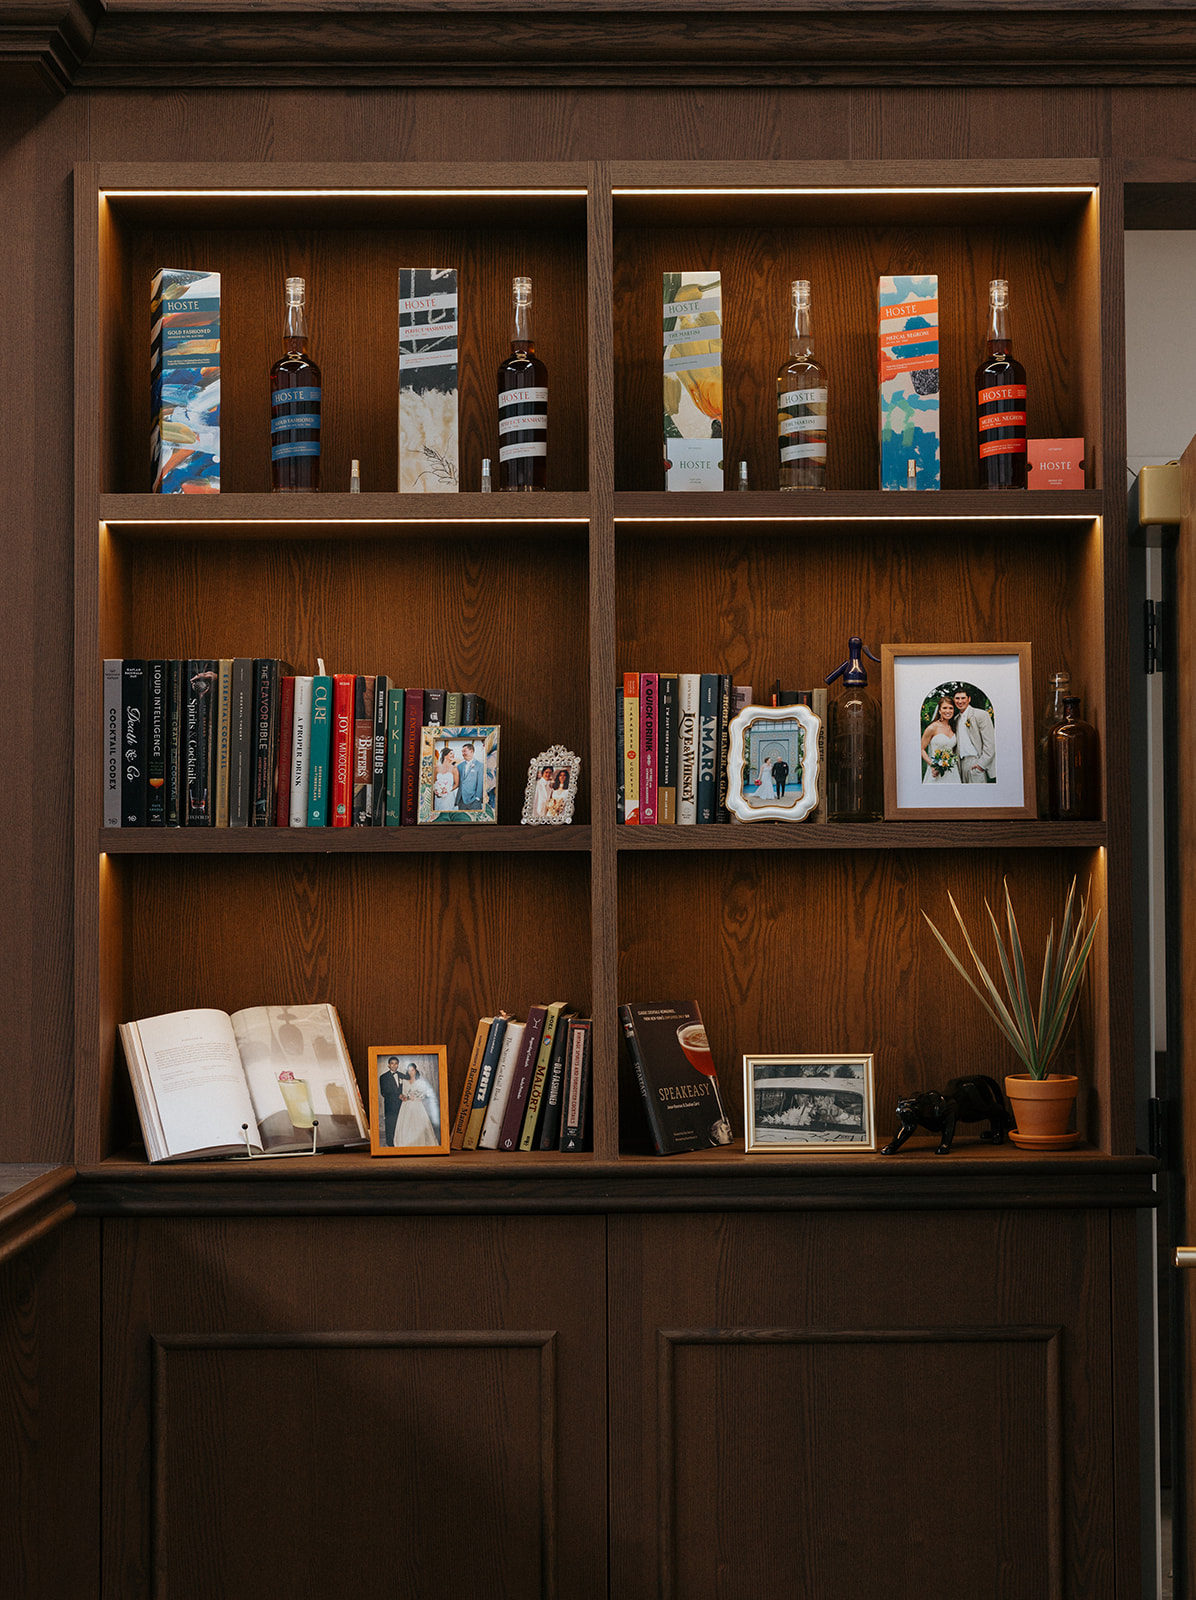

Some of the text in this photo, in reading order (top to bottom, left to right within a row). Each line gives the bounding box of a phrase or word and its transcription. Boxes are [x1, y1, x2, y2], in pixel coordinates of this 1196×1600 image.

[168, 301, 200, 310] HOSTE
[404, 298, 436, 310] HOSTE
[669, 302, 700, 313] HOSTE
[886, 305, 917, 317] HOSTE
[275, 391, 304, 402] HOSTE
[501, 391, 530, 403] HOSTE
[785, 392, 815, 404] HOSTE
[982, 389, 1012, 400] HOSTE
[680, 461, 712, 469] HOSTE
[1040, 461, 1072, 470] HOSTE
[187, 698, 197, 730] Spirits
[260, 680, 269, 720] FLAVOR
[314, 686, 327, 725] CURE
[259, 722, 268, 750] BIBLE
[338, 714, 348, 735] JOY
[408, 717, 416, 766] ENCYCLOPEDIA
[679, 710, 696, 745] LOVE
[125, 706, 141, 782] Death & Co
[358, 738, 373, 776] BITTERS
[374, 735, 384, 774] SHRUBS
[702, 716, 715, 782] AMARO
[188, 740, 197, 784] Cocktails
[338, 742, 346, 785] MIXOLOGY
[682, 751, 695, 804] WHISKEY
[466, 1067, 478, 1106] Bartenders'
[477, 1065, 492, 1101] SPRITZ
[529, 1065, 546, 1112] MALÖRT
[549, 1062, 562, 1106] OLD-FASHIONED
[633, 1061, 647, 1098] SPEAKEASY
[659, 1083, 710, 1101] SPEAKEASY
[457, 1107, 468, 1134] Manual
